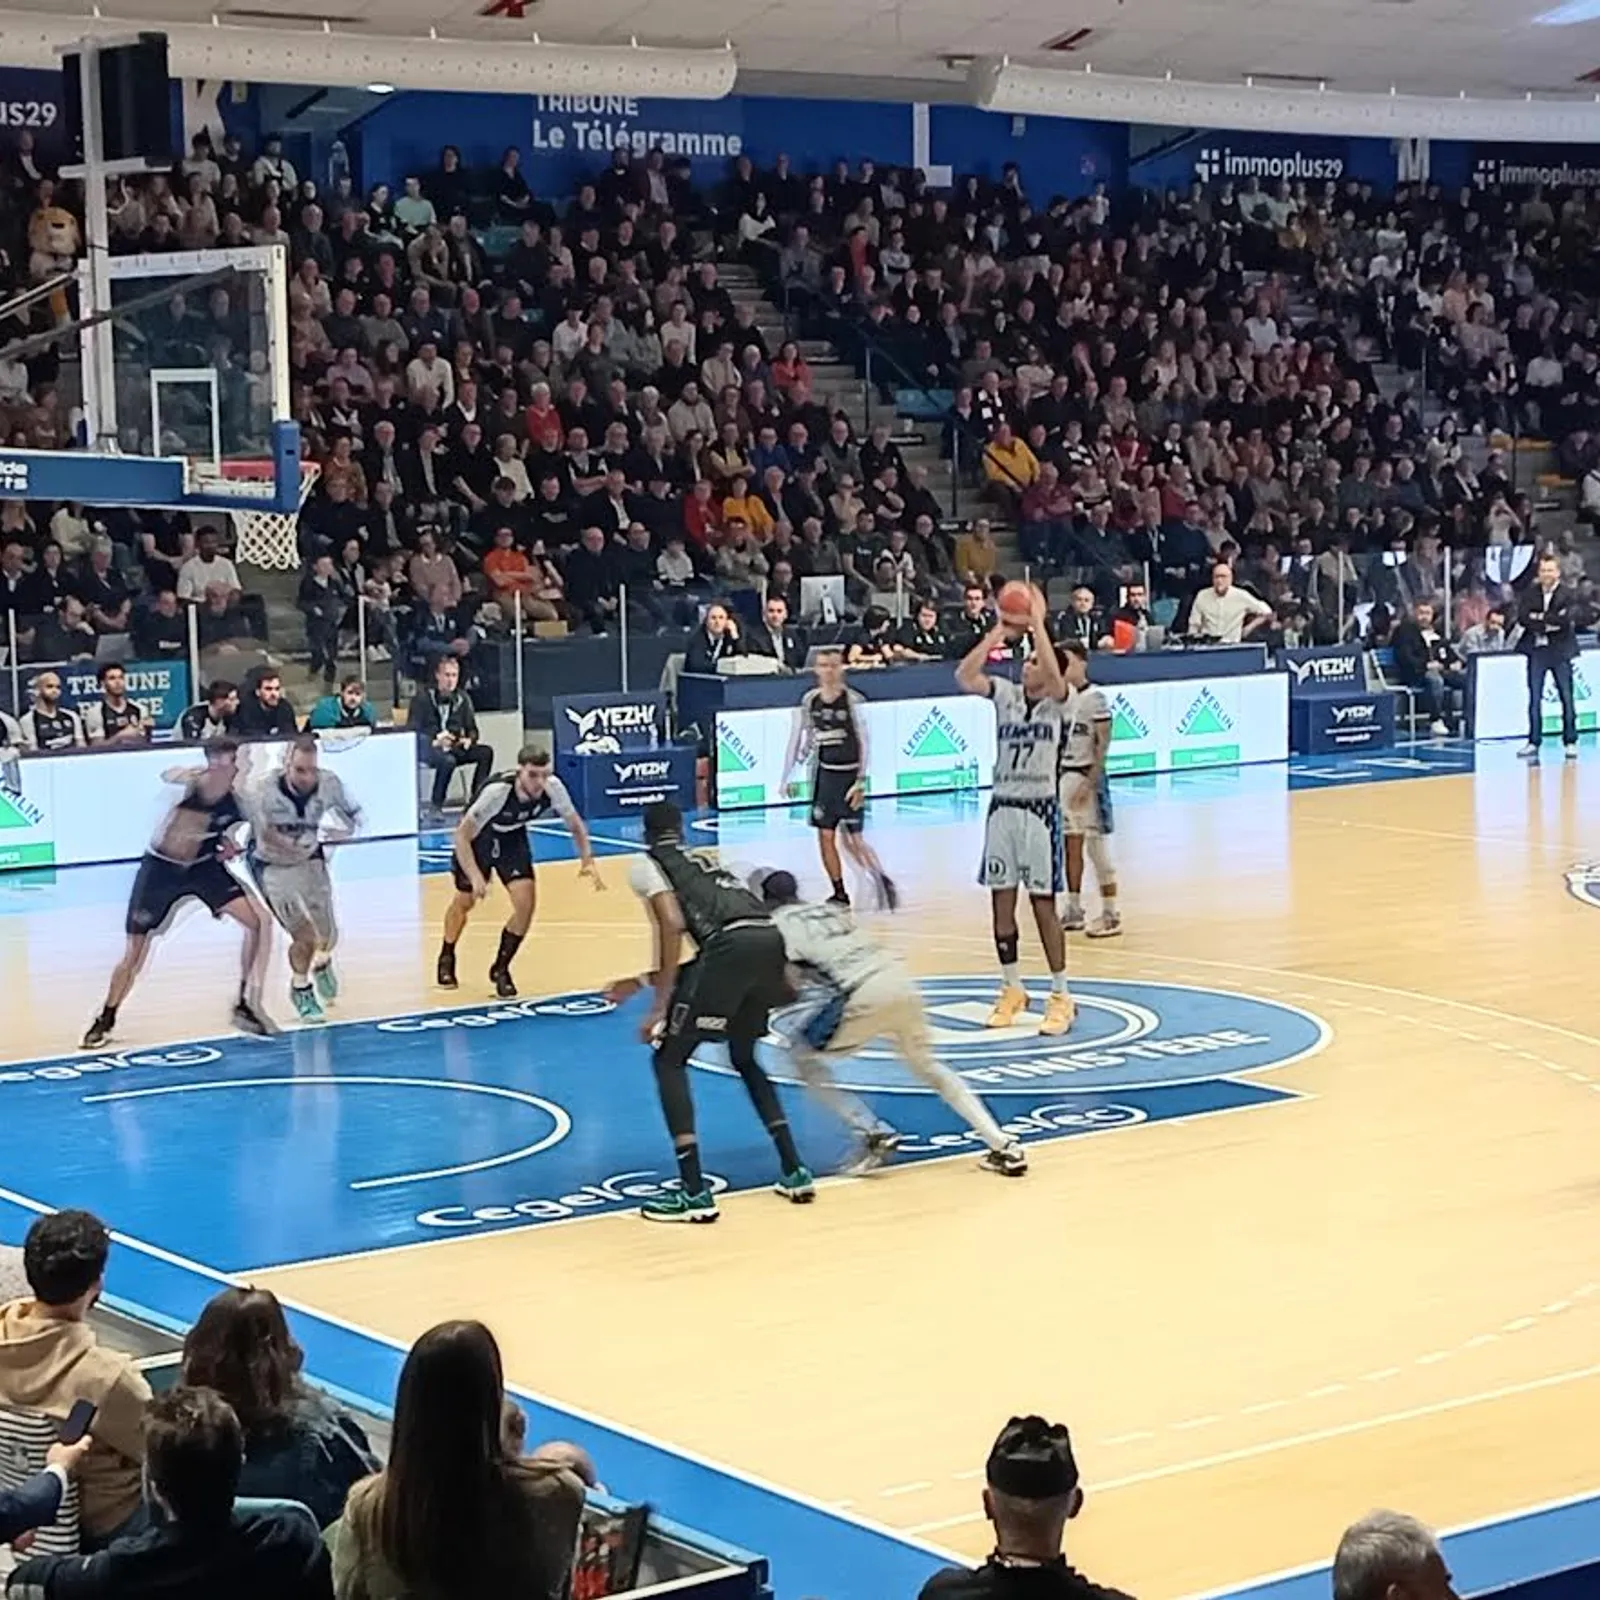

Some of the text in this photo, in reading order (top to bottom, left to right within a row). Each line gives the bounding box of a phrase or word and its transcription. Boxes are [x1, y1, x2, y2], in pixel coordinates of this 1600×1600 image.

[533, 119, 743, 159] Le Télégramme
[1225, 147, 1344, 181] immoplus29
[67, 671, 171, 695] TRUNE
[1115, 692, 1150, 737] MERLIN
[1176, 685, 1235, 734] LEROY MERLIN
[902, 705, 969, 756] LEROY MERLIN
[1008, 742, 1035, 770] 77
[377, 998, 617, 1033] Cegelec
